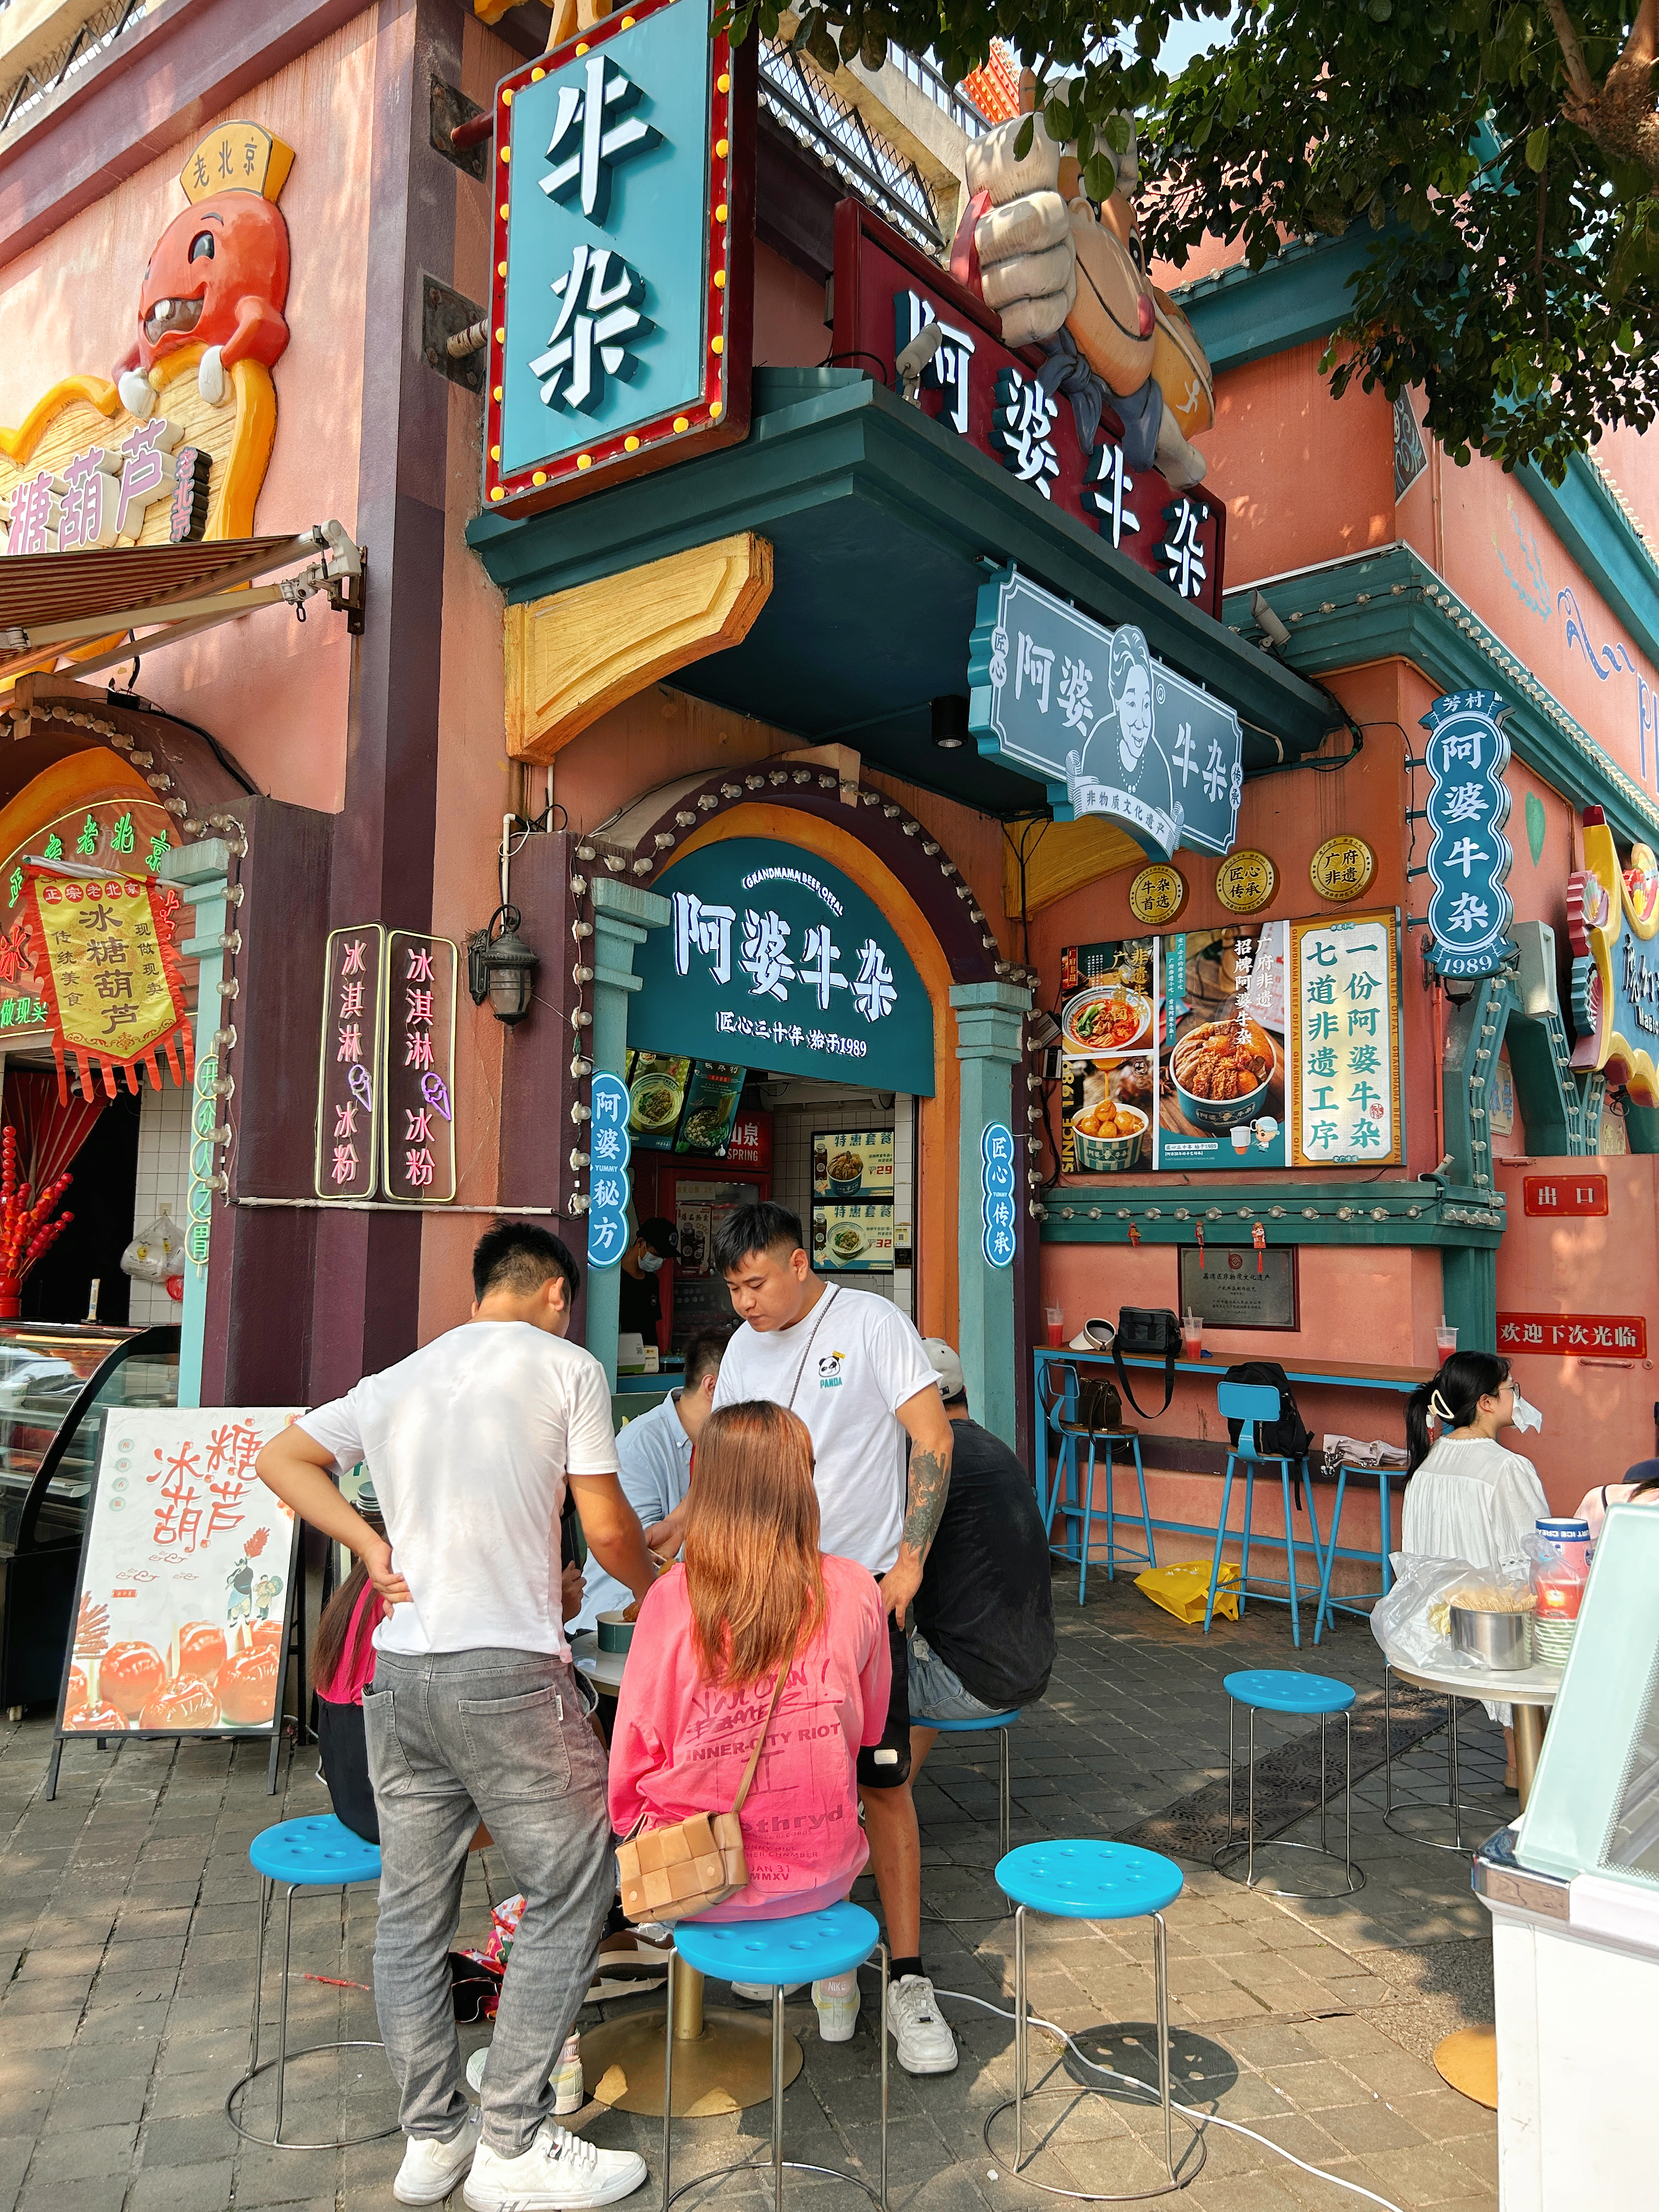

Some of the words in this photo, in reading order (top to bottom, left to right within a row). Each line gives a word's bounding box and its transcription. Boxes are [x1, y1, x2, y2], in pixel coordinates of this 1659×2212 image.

[193, 136, 258, 189] 老北京
[528, 54, 649, 409] 牛杂
[909, 289, 1206, 598] 阿婆牛杂
[7, 417, 167, 556] 糖葫芦
[170, 447, 198, 543] 老北京
[992, 633, 1006, 681] 匠心
[1015, 631, 1094, 737] 阿婆
[1171, 721, 1228, 803] 牛杂
[1442, 690, 1486, 713] 芳村
[1231, 768, 1242, 805] 传承
[1086, 789, 1165, 834] 非物质文化遗产
[1441, 731, 1489, 933] 阿婆牛杂
[1230, 866, 1261, 882] 匠心
[1323, 849, 1359, 869] 广府
[1324, 867, 1357, 885] 非遗
[44, 881, 140, 904] 正宗老北京
[742, 867, 802, 889] GRANDMAMA
[802, 872, 821, 891] BEEF
[817, 887, 844, 917] OFFAL
[1141, 878, 1170, 895] 牛杂
[1141, 894, 1171, 911] 首选
[1228, 882, 1261, 898] 传承
[53, 930, 85, 1007] 传统美食
[79, 903, 140, 1035] 冰糖葫芦
[134, 924, 164, 995] 现做现卖
[673, 891, 898, 1023] 阿婆牛杂
[1443, 955, 1493, 974] 1989
[337, 939, 368, 1063] 冰淇淋
[404, 947, 435, 1071] 冰淇淋
[1234, 939, 1255, 1046] 招牌阿婆牛杂
[715, 1011, 805, 1047] 匠心三十年
[806, 1029, 867, 1057] 始于1989
[1306, 942, 1339, 1150] 七道非遗工序
[1343, 943, 1383, 1148] 一份阿婆牛杂
[1062, 1060, 1074, 1108] 1989
[331, 1100, 359, 1185] 冰粉
[404, 1107, 436, 1186] 冰粉
[594, 1091, 622, 1160] 阿婆
[1062, 1118, 1074, 1172] SINCE
[193, 1062, 218, 1259] 开众人之胃
[595, 1164, 618, 1173] YUMMY
[727, 1148, 758, 1161] SPRING
[991, 1136, 1008, 1184] 匠心
[591, 1178, 619, 1249] 秘方
[1537, 1186, 1594, 1206] 出口
[992, 1201, 1011, 1255] 传承
[1499, 1322, 1637, 1347] 欢迎下次光临
[820, 1376, 843, 1389] PANDA
[146, 1425, 263, 1487] 冰糖
[153, 1480, 251, 1553] 葫芦
[1536, 1528, 1559, 1537] CREA
[798, 1722, 841, 1741] RIOT
[749, 1872, 790, 1881] MMXV
[751, 1865, 773, 1873] JAN
[827, 1980, 848, 1993] NIKE
[564, 2044, 577, 2058] NIK
